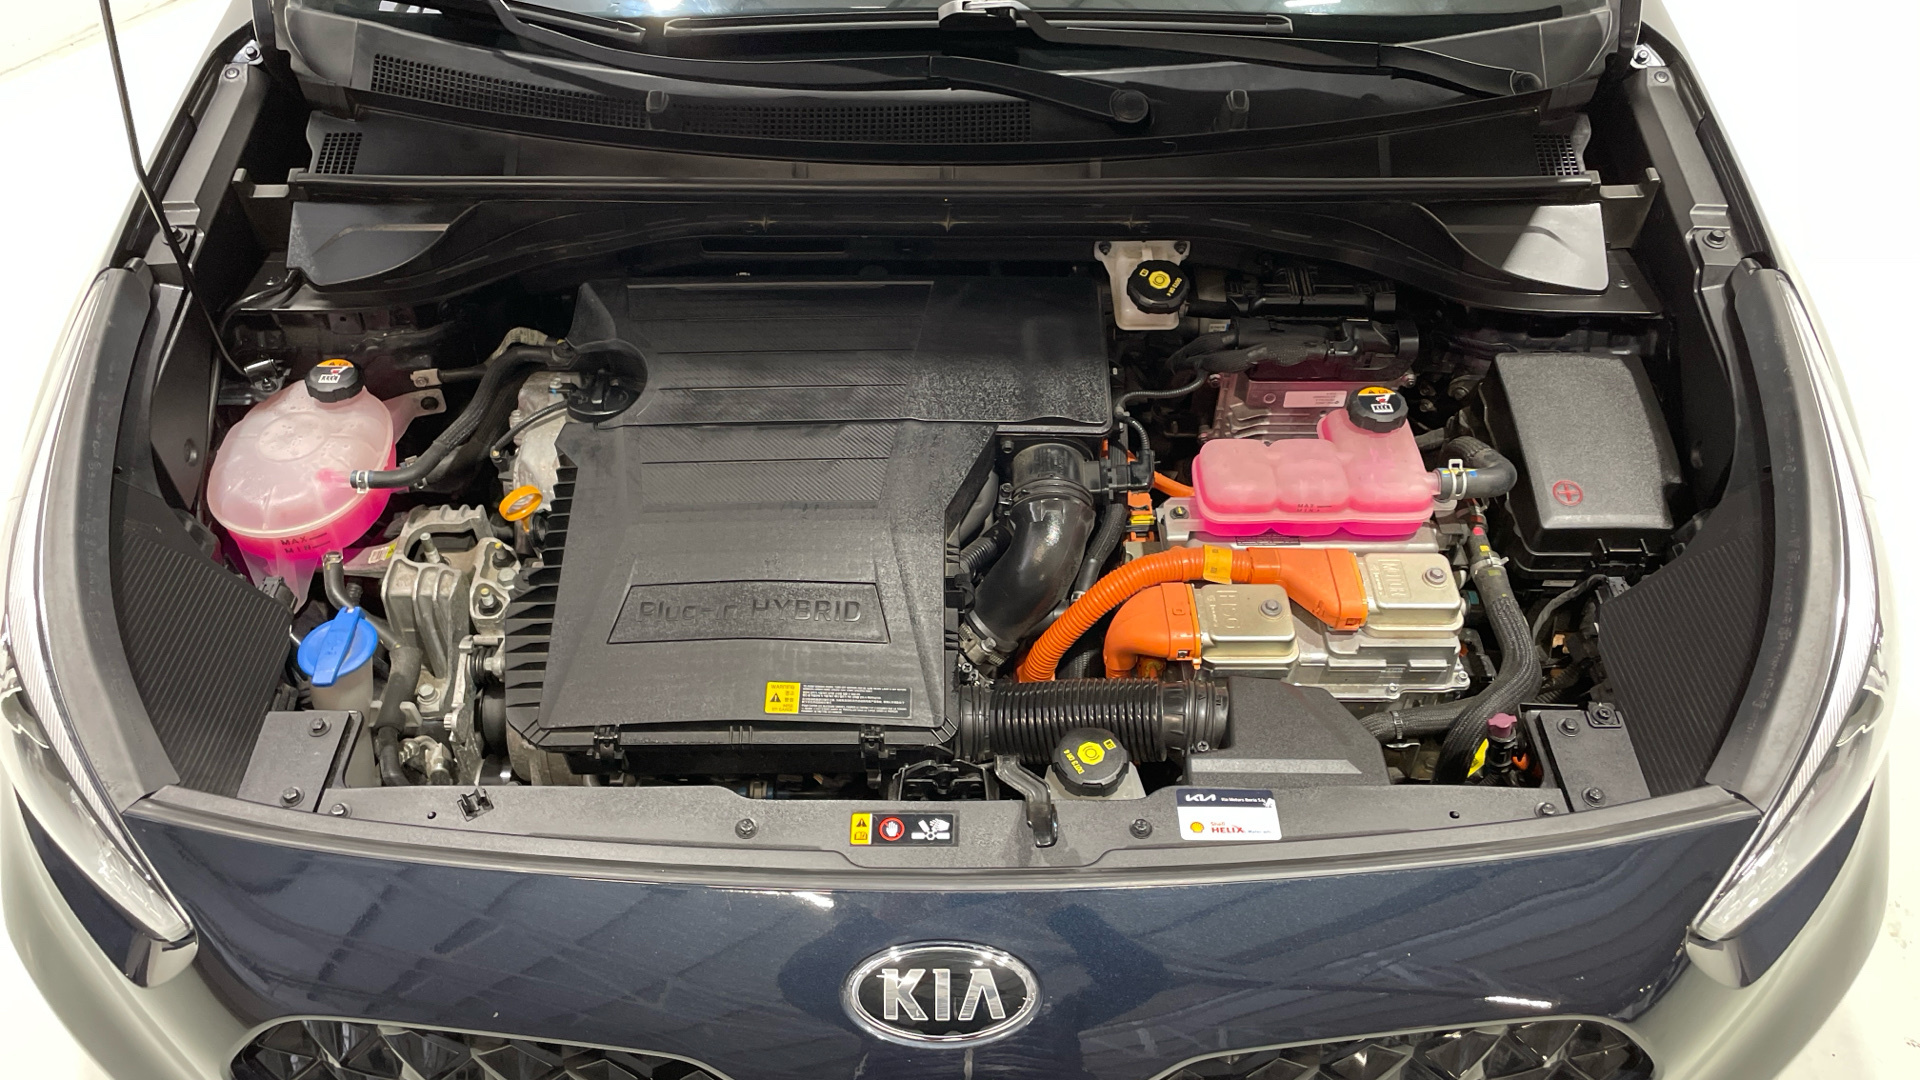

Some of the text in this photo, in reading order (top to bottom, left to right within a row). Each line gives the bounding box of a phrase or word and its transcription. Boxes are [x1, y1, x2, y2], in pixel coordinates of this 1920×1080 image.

[280, 536, 307, 546] MAX
[638, 599, 861, 626] Plug-in HYBRID
[1211, 825, 1245, 833] HELIX
[881, 968, 1006, 1021] KIA
